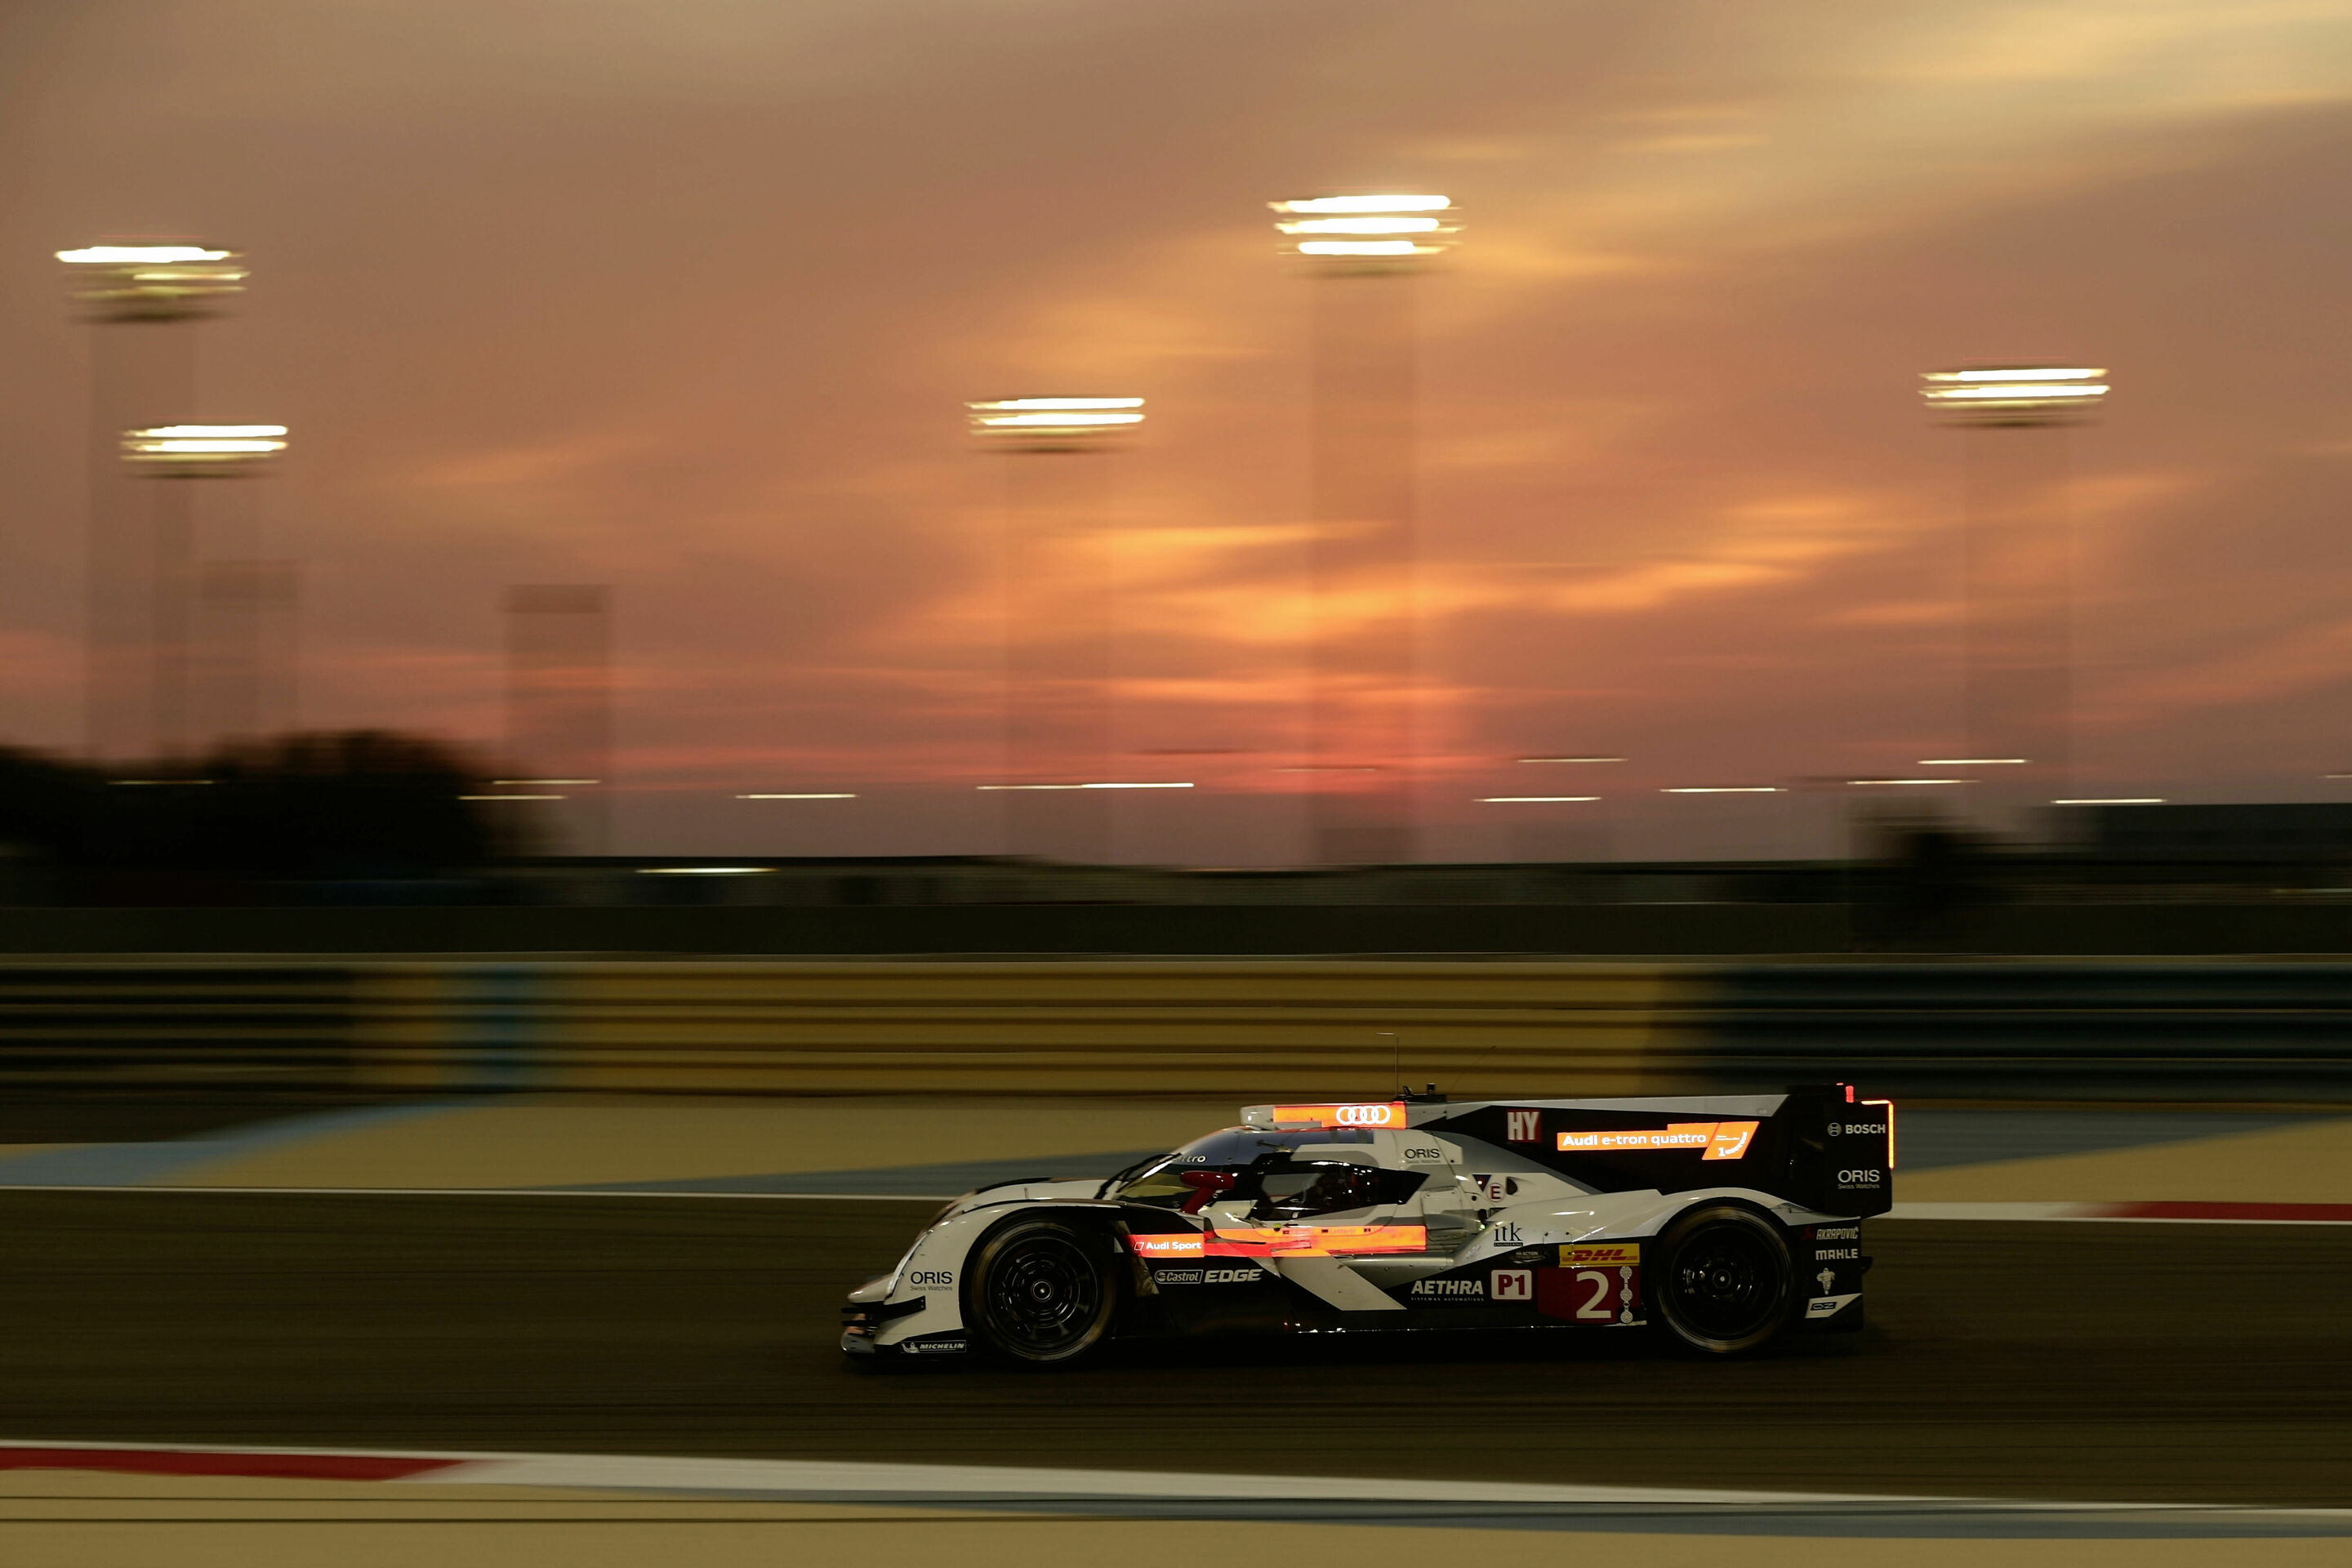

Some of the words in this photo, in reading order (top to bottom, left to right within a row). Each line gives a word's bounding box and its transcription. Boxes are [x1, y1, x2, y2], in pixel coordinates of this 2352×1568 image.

[1508, 1111, 1540, 1141] HY
[1845, 1124, 1886, 1134] BOSCH
[1562, 1135, 1598, 1147] Audi
[1601, 1135, 1647, 1146] e-tron
[1650, 1134, 1707, 1147] quattro
[1405, 1148, 1440, 1159] ORIS
[1838, 1169, 1881, 1183] ORIS
[1490, 1186, 1501, 1200] E
[1494, 1222, 1523, 1241] itk
[1146, 1241, 1169, 1250] Audi
[1172, 1241, 1202, 1251] Sport
[1571, 1249, 1628, 1262] DHL
[1815, 1248, 1859, 1261] MAHLE
[911, 1271, 953, 1285] ORIS
[1166, 1272, 1199, 1282] Castrol
[1204, 1268, 1264, 1283] EDGE
[1410, 1280, 1484, 1294] AETHRA
[1498, 1274, 1526, 1296] P1
[1576, 1270, 1612, 1319] 2
